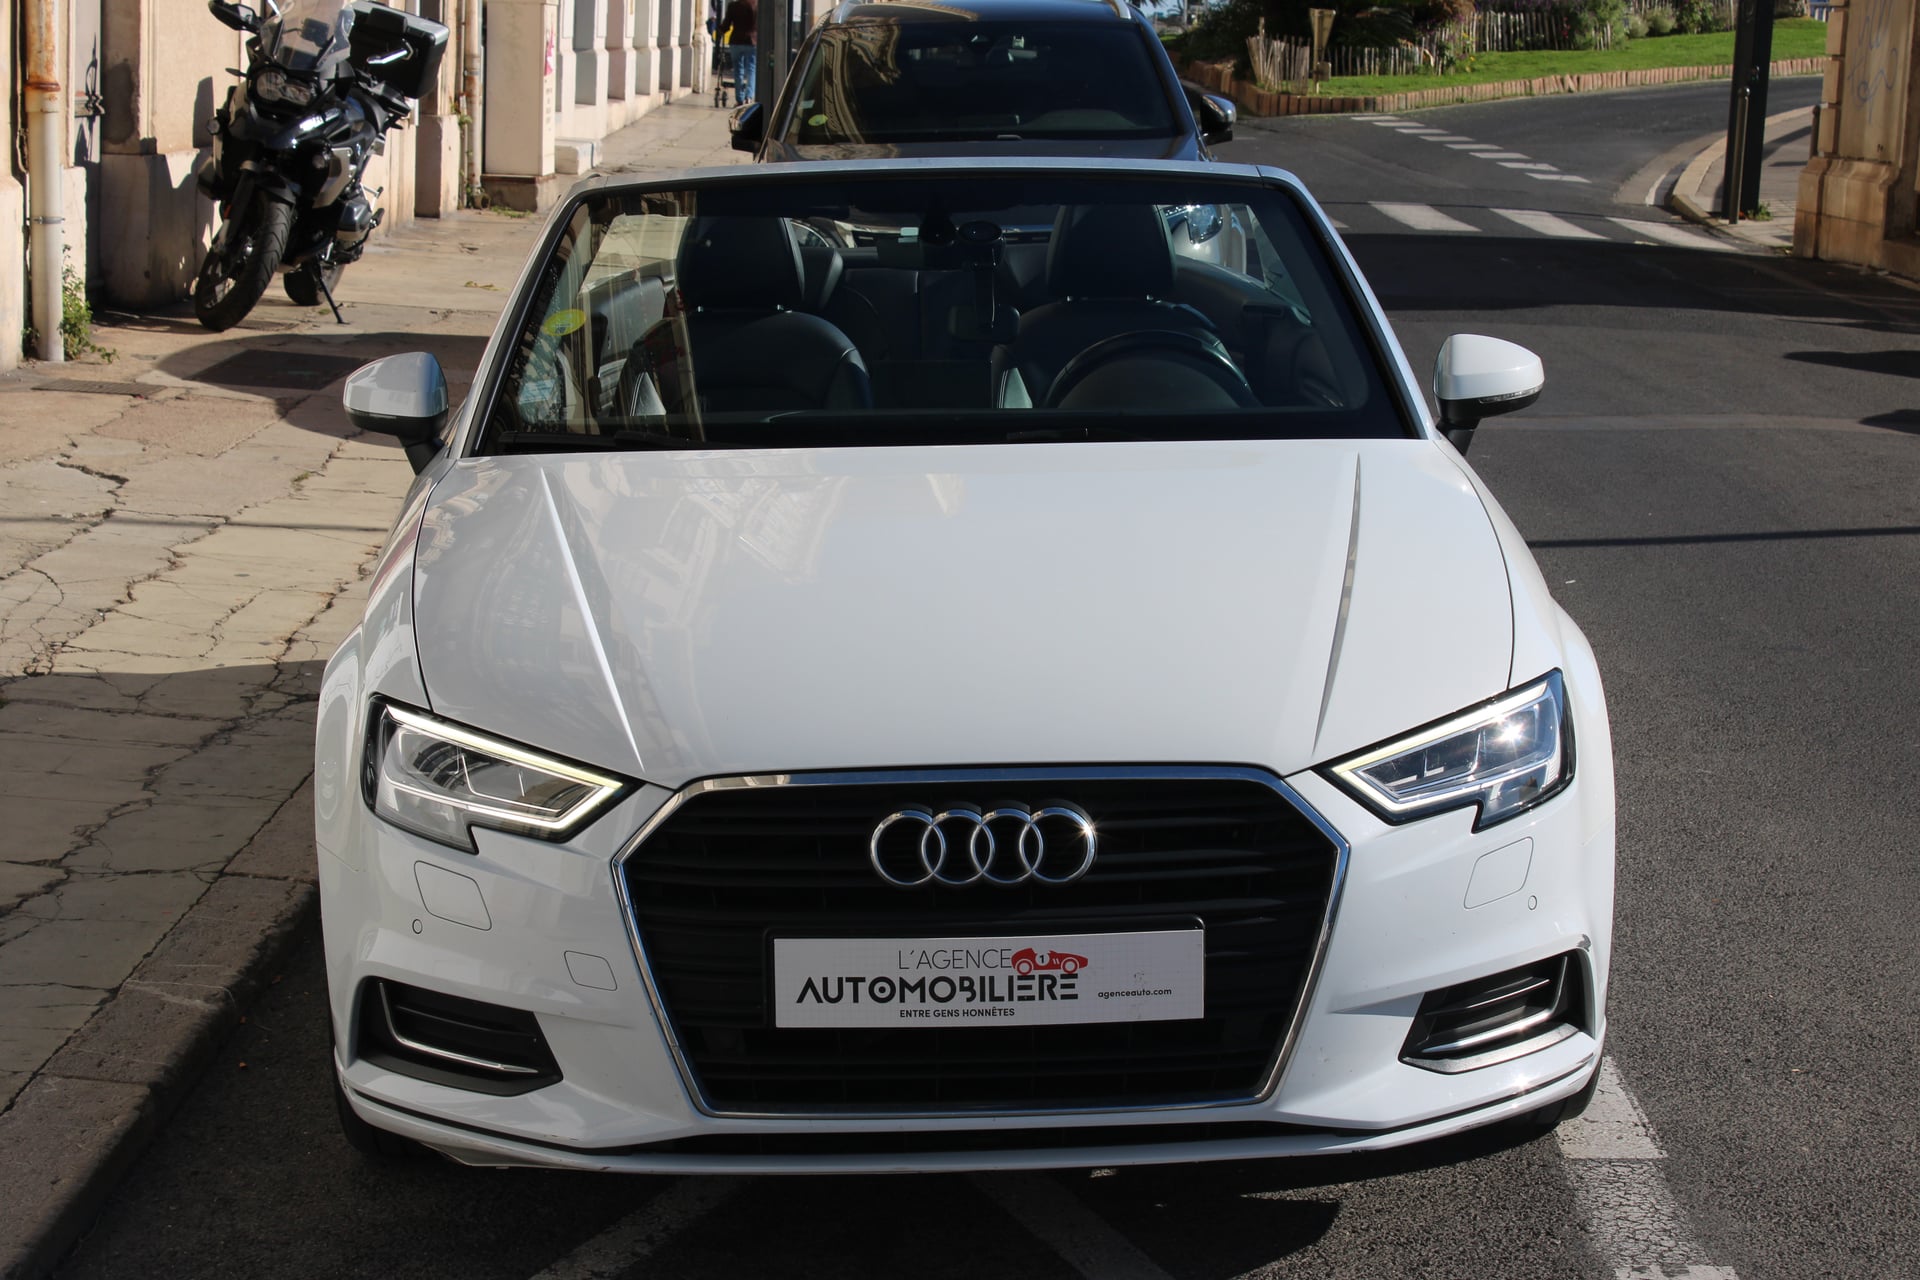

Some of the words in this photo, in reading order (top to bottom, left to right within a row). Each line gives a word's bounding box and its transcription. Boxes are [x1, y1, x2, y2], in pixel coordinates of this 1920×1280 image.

[898, 948, 1012, 969] L'AGENCE
[1039, 954, 1045, 964] 1
[1097, 988, 1172, 999] agenceauto.com
[900, 1009, 931, 1018] ENTRE
[933, 1009, 960, 1018] GENS
[962, 1006, 1015, 1018] HONNÊTES
